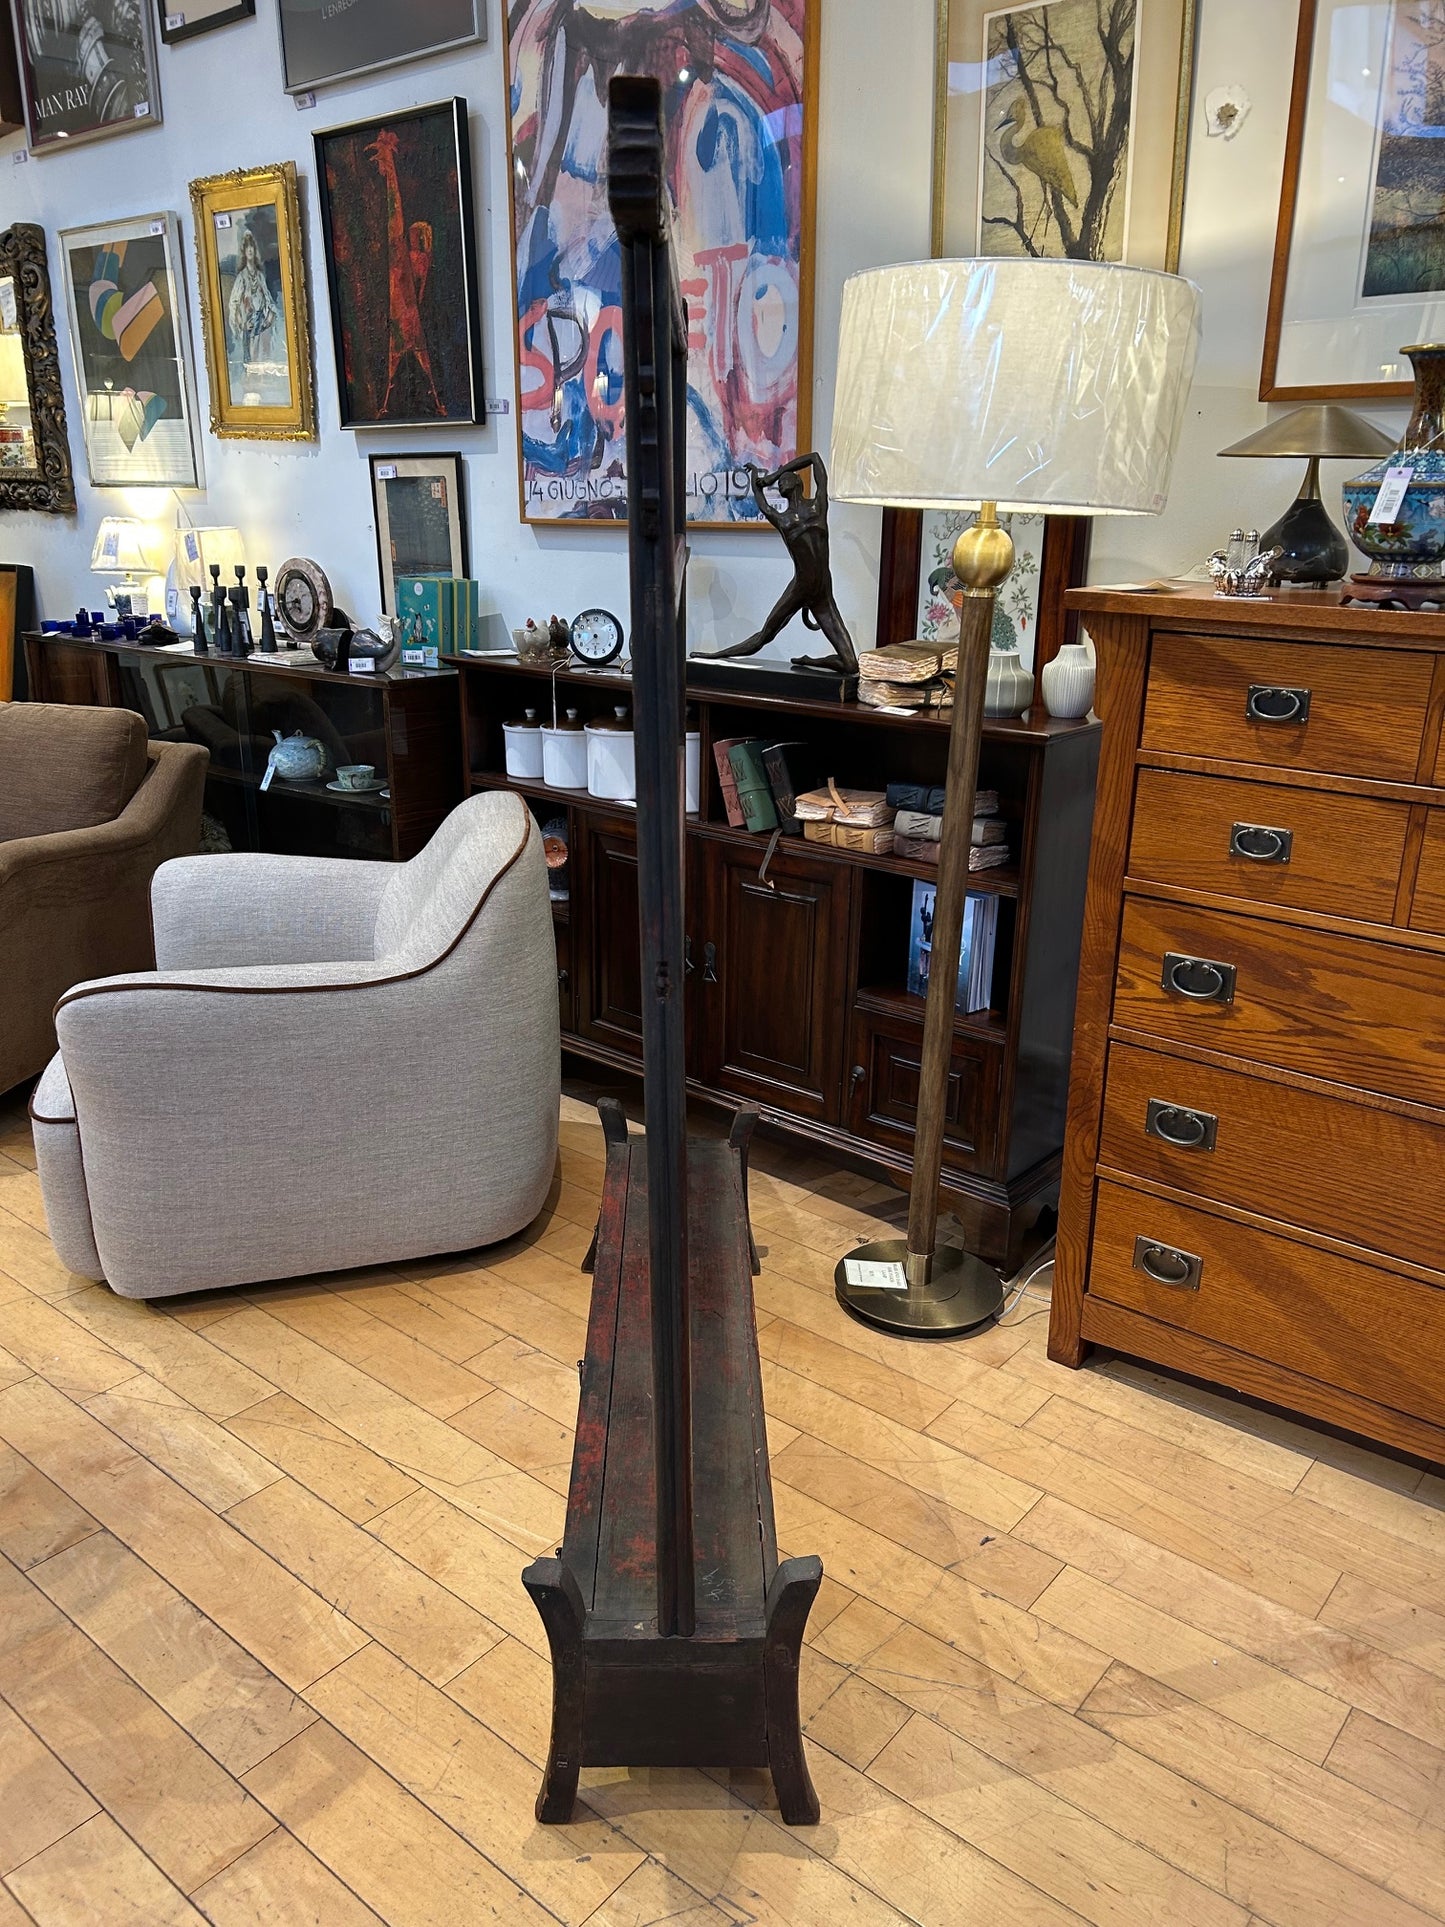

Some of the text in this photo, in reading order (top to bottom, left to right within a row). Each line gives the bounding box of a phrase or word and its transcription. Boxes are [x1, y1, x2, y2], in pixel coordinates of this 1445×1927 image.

[321, 0, 360, 20] L'ENREG
[34, 84, 89, 120] MAN RAY
